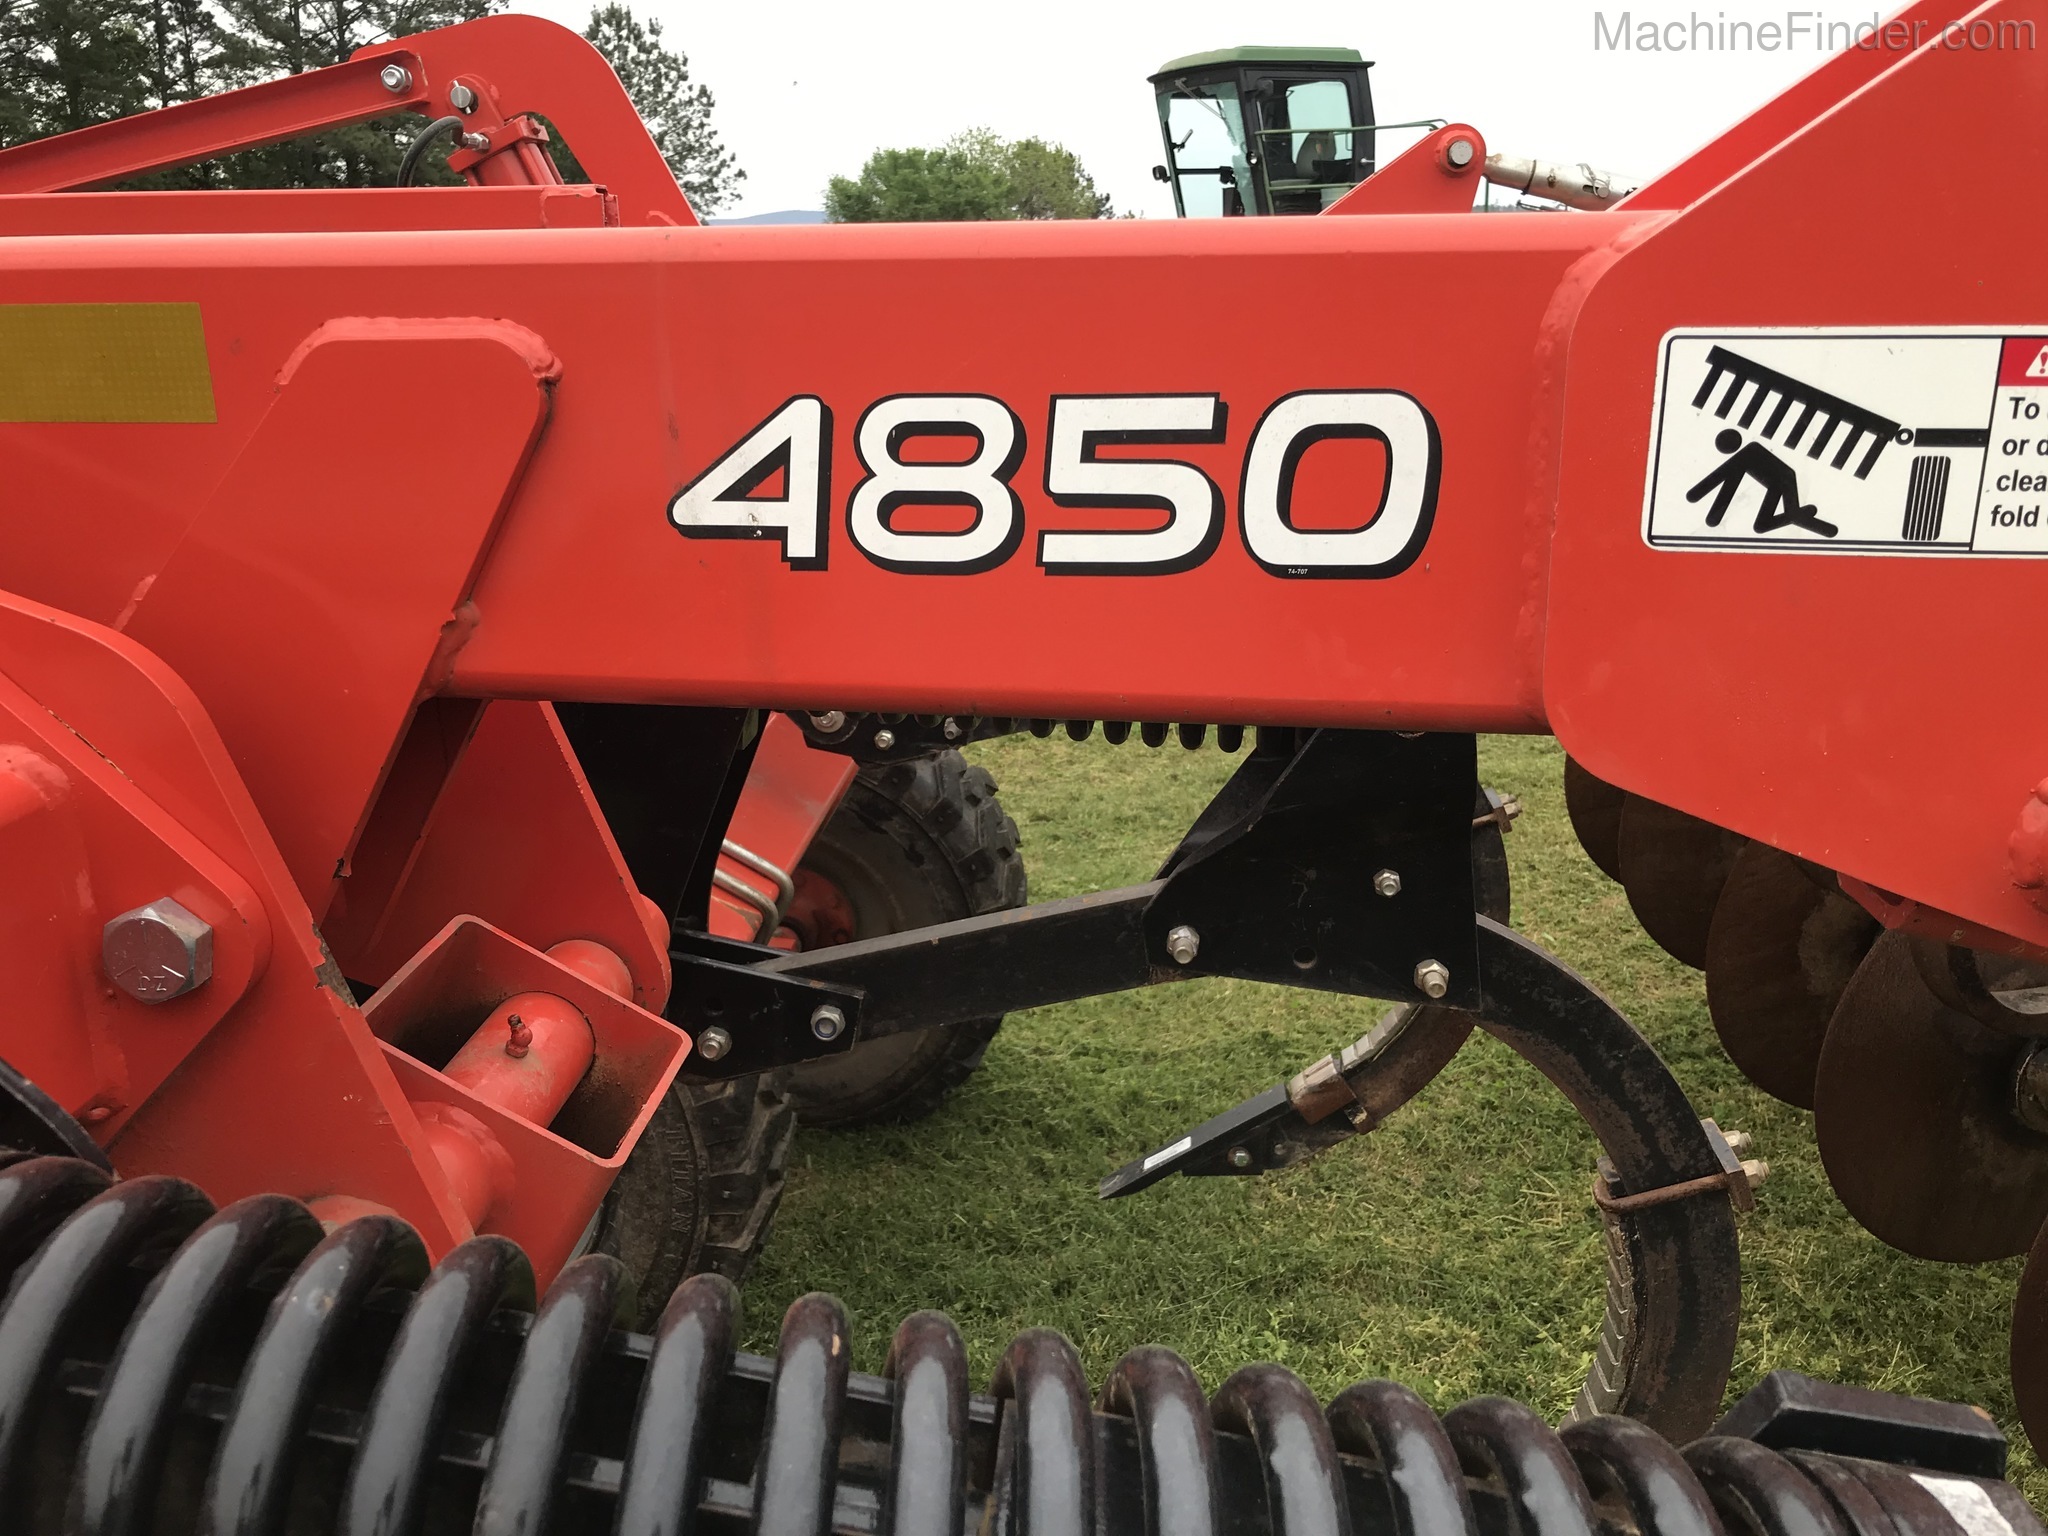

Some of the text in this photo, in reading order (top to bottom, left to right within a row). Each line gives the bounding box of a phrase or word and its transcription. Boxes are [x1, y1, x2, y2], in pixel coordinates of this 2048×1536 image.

[2009, 396, 2041, 420] To
[2002, 437, 2030, 456] or
[666, 389, 1441, 579] 4850
[1991, 504, 2040, 527] fold
[665, 1125, 695, 1234] TITAN
